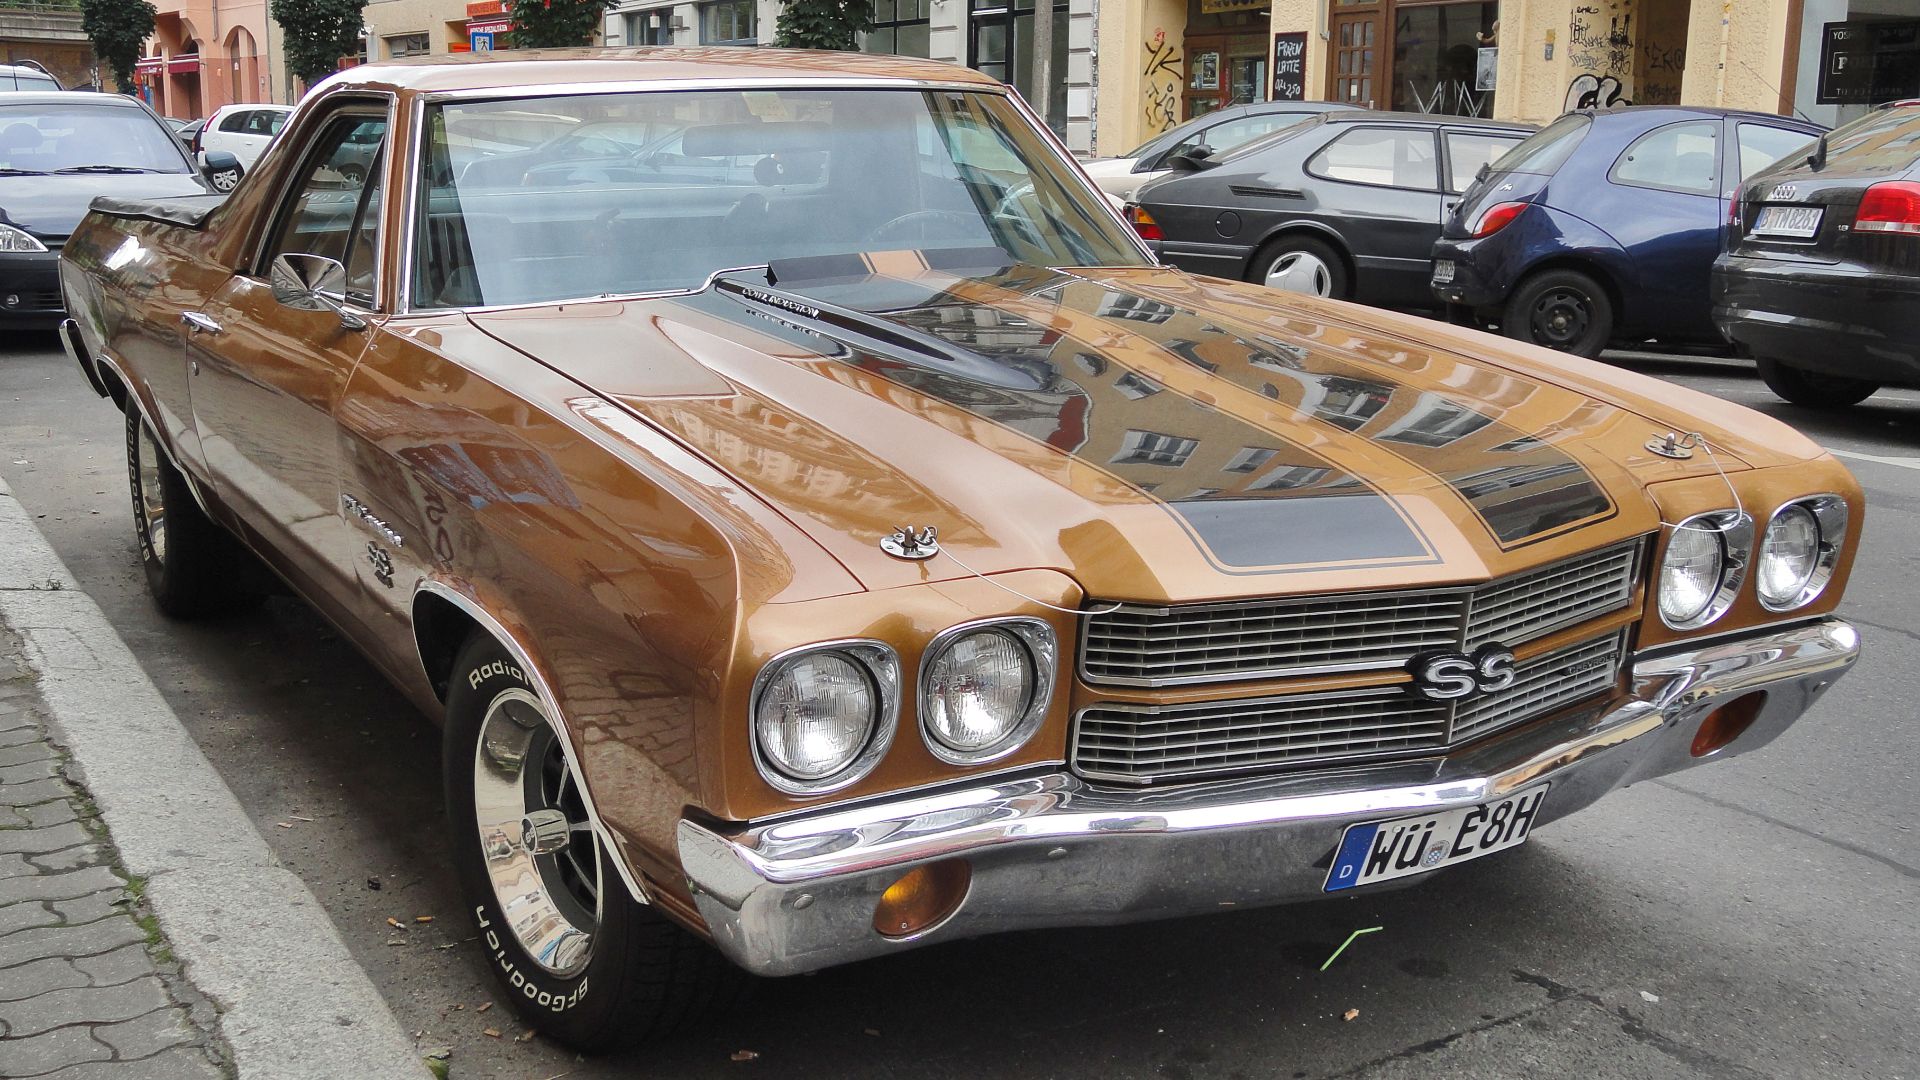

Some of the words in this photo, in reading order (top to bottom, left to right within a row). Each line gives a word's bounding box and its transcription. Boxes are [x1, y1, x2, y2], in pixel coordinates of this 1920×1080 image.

[1277, 59, 1300, 74] LATTE
[769, 296, 820, 318] INDUCTION
[1422, 651, 1515, 700] SS
[1364, 820, 1437, 877] WÜ
[1339, 864, 1353, 879] D
[476, 905, 588, 1012] BFGoodrich
